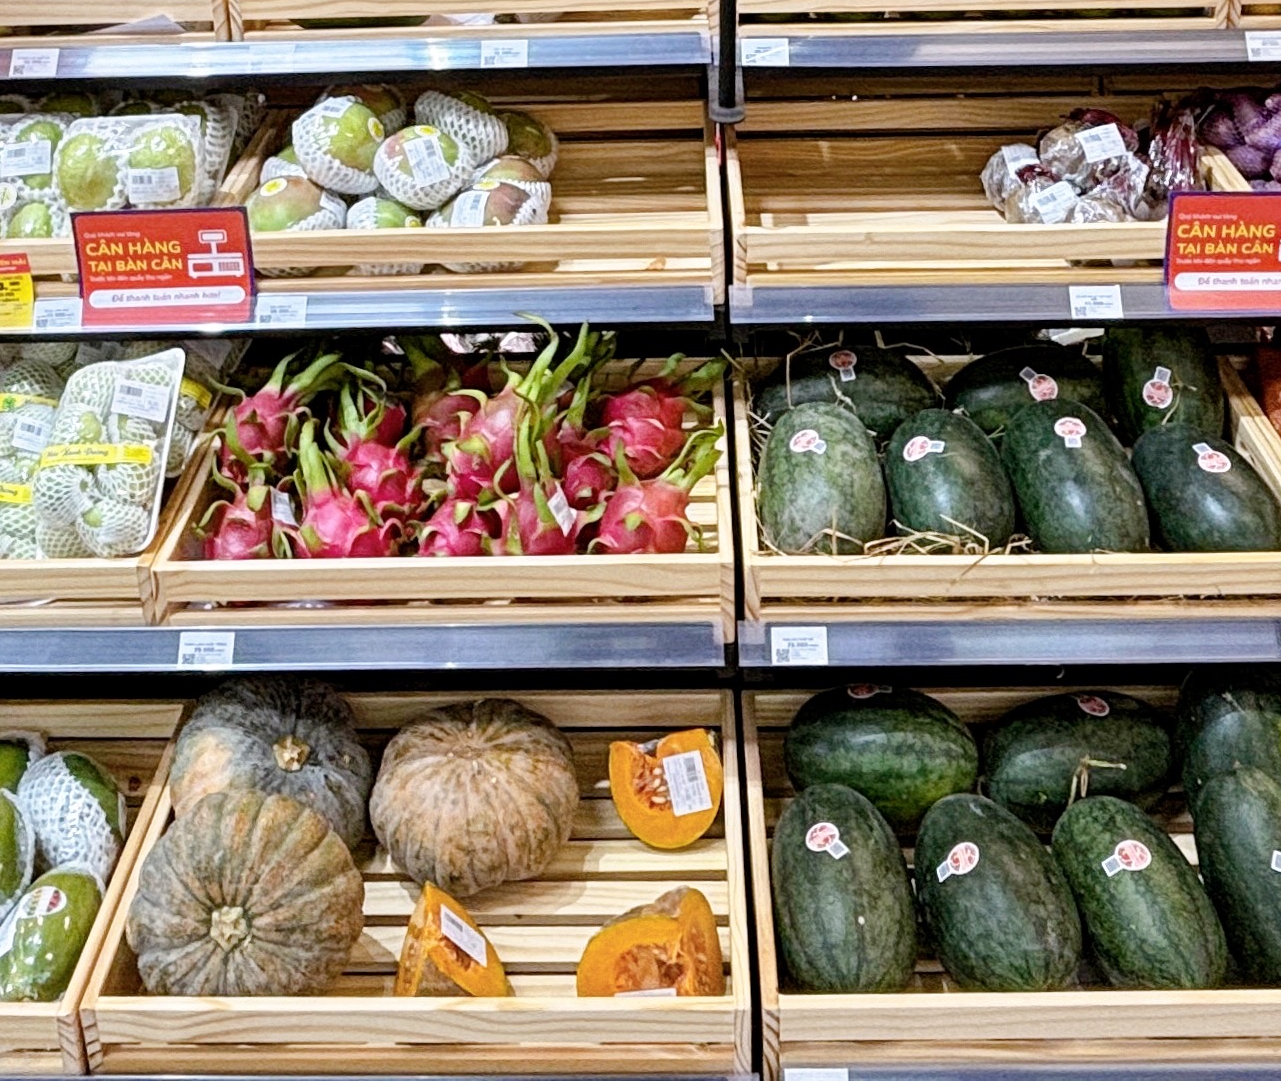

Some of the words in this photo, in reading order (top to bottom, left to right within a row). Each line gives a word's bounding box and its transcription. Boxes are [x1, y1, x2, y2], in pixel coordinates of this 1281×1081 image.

[1177, 221, 1217, 238] CÂN
[1222, 221, 1276, 239] HÀNG
[86, 239, 124, 256] CÂN
[129, 238, 181, 255] HÀNG
[1177, 242, 1201, 258] TẠI
[1205, 240, 1237, 255] BÀN
[1241, 240, 1274, 255] CÂN
[88, 260, 112, 276] TẠI
[116, 257, 147, 272] BÀN
[151, 255, 183, 270] CÂN
